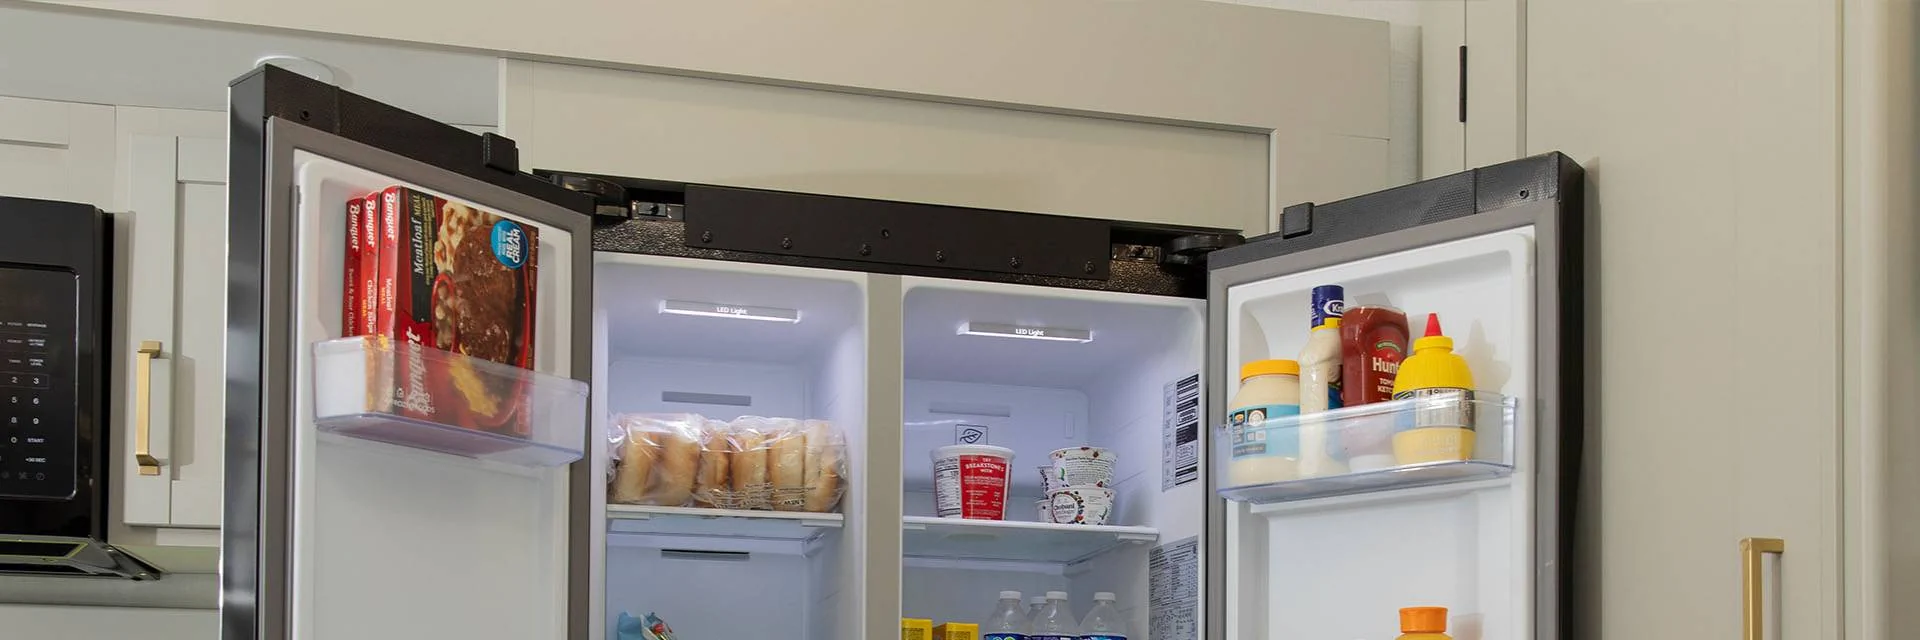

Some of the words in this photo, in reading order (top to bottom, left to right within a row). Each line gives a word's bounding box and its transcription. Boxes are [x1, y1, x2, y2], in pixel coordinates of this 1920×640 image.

[413, 194, 421, 216] MEAL
[366, 199, 377, 247] Banquet
[384, 192, 397, 241] Banquet
[349, 204, 361, 252] Banquet
[411, 217, 424, 275] Meatloaf
[506, 230, 514, 259] REAL
[512, 228, 521, 264] CREAM
[366, 279, 375, 310] Chicken
[384, 277, 393, 312] Meatloaf
[730, 307, 748, 316] Light
[1028, 328, 1044, 337] Light
[11, 376, 18, 384] 2
[33, 377, 40, 385] 3
[11, 396, 18, 404] 5
[33, 397, 40, 405] 6
[11, 416, 18, 424] 8
[33, 417, 40, 425] 9
[10, 436, 18, 444] 0
